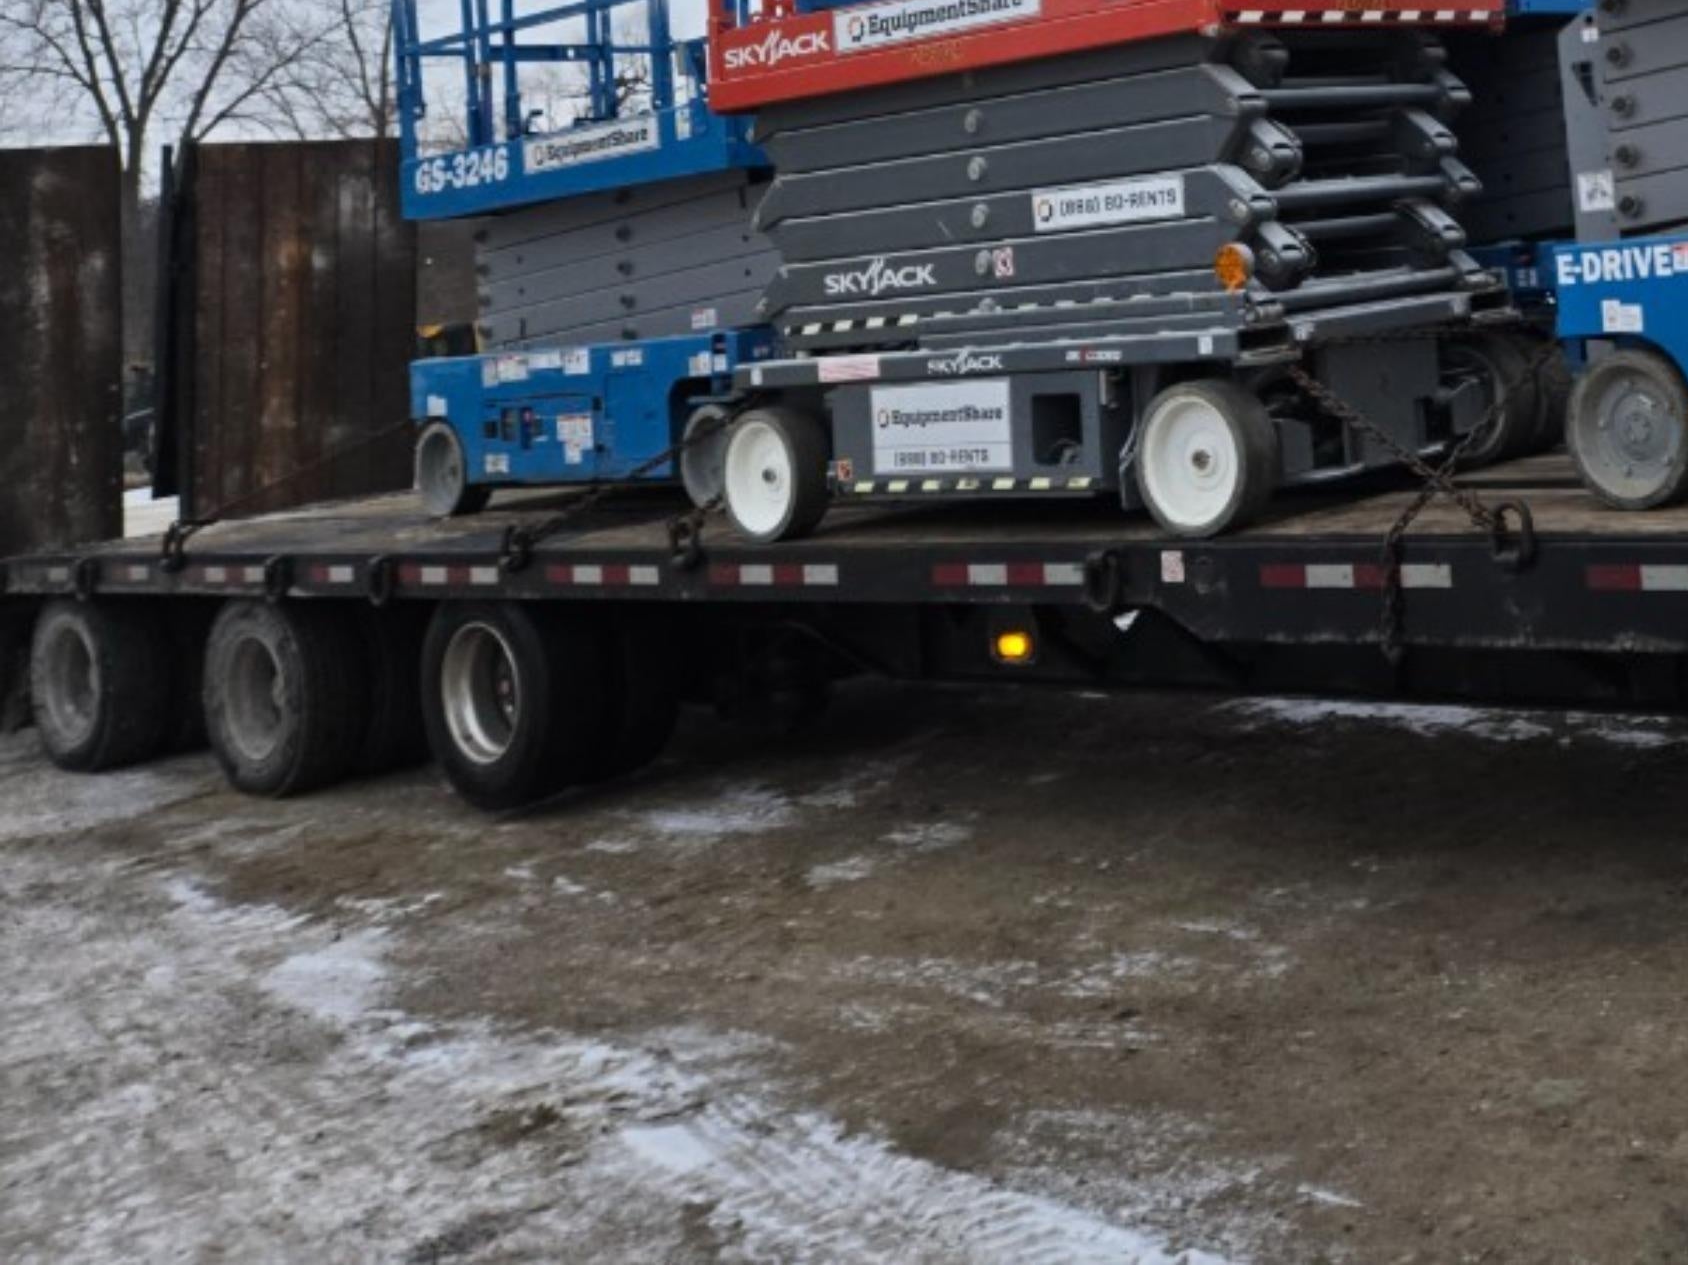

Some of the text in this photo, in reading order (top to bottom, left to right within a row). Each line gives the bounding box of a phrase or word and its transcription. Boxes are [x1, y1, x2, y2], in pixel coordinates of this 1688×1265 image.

[724, 28, 830, 69] SKYJACK
[415, 147, 510, 195] GS-3246
[823, 255, 938, 296] SKYJACK
[1556, 243, 1674, 286] E-DRIVE
[927, 346, 1004, 375] SKYJACK
